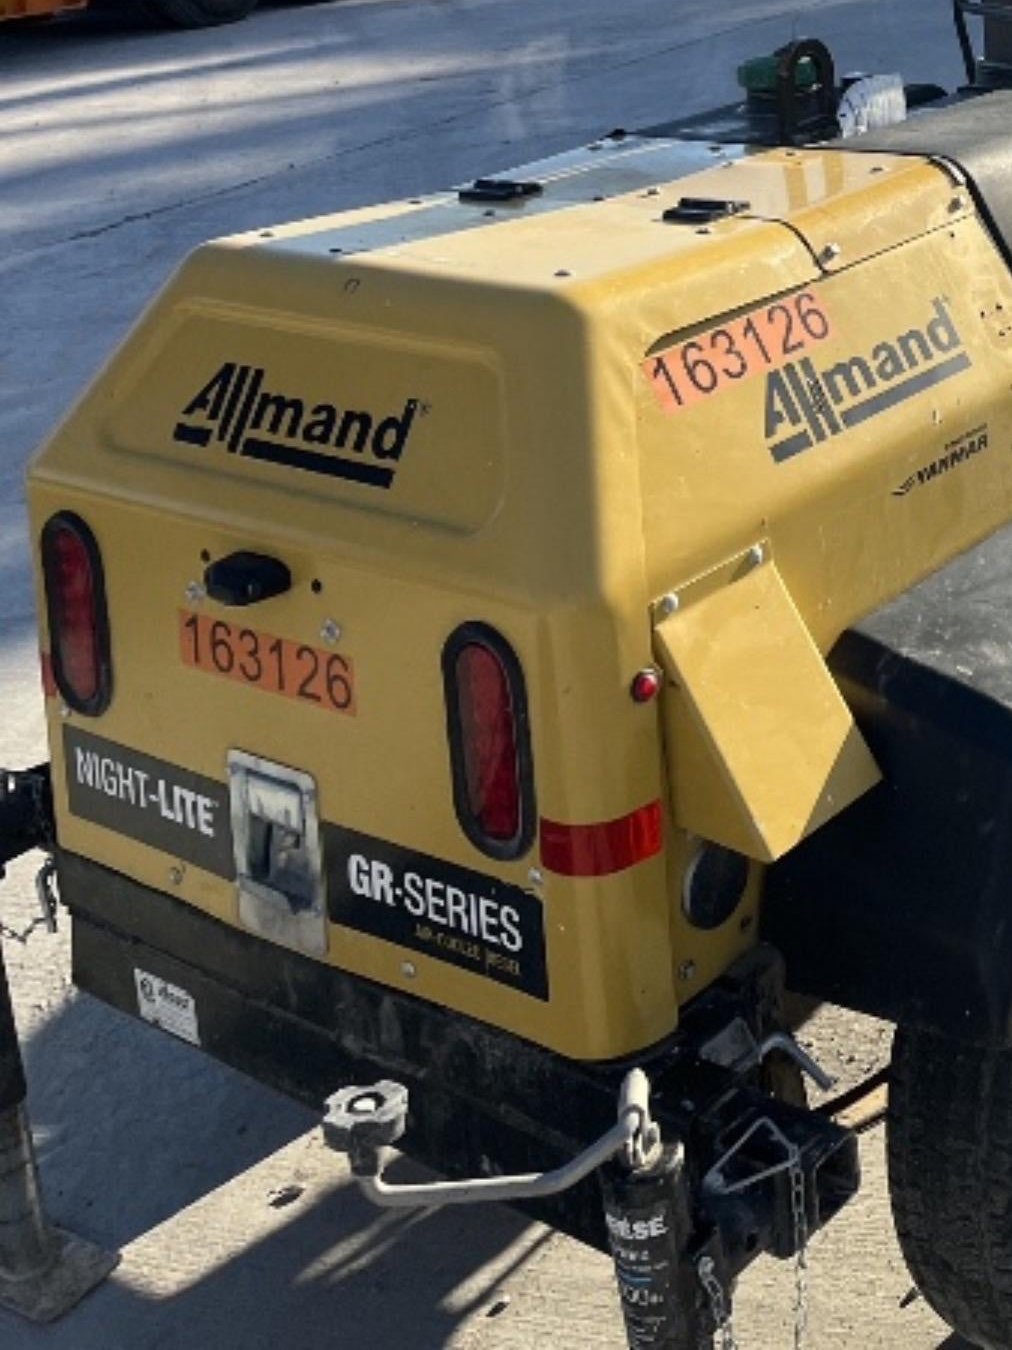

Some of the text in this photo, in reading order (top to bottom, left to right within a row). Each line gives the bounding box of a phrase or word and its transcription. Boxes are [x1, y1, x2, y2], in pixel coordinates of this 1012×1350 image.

[651, 292, 830, 406] 163126
[764, 296, 962, 443] Allmand
[181, 362, 419, 462] Allmand
[184, 613, 352, 709] 163126
[74, 746, 215, 838] NIGHT-LITE
[348, 854, 523, 952] GR-SERIES
